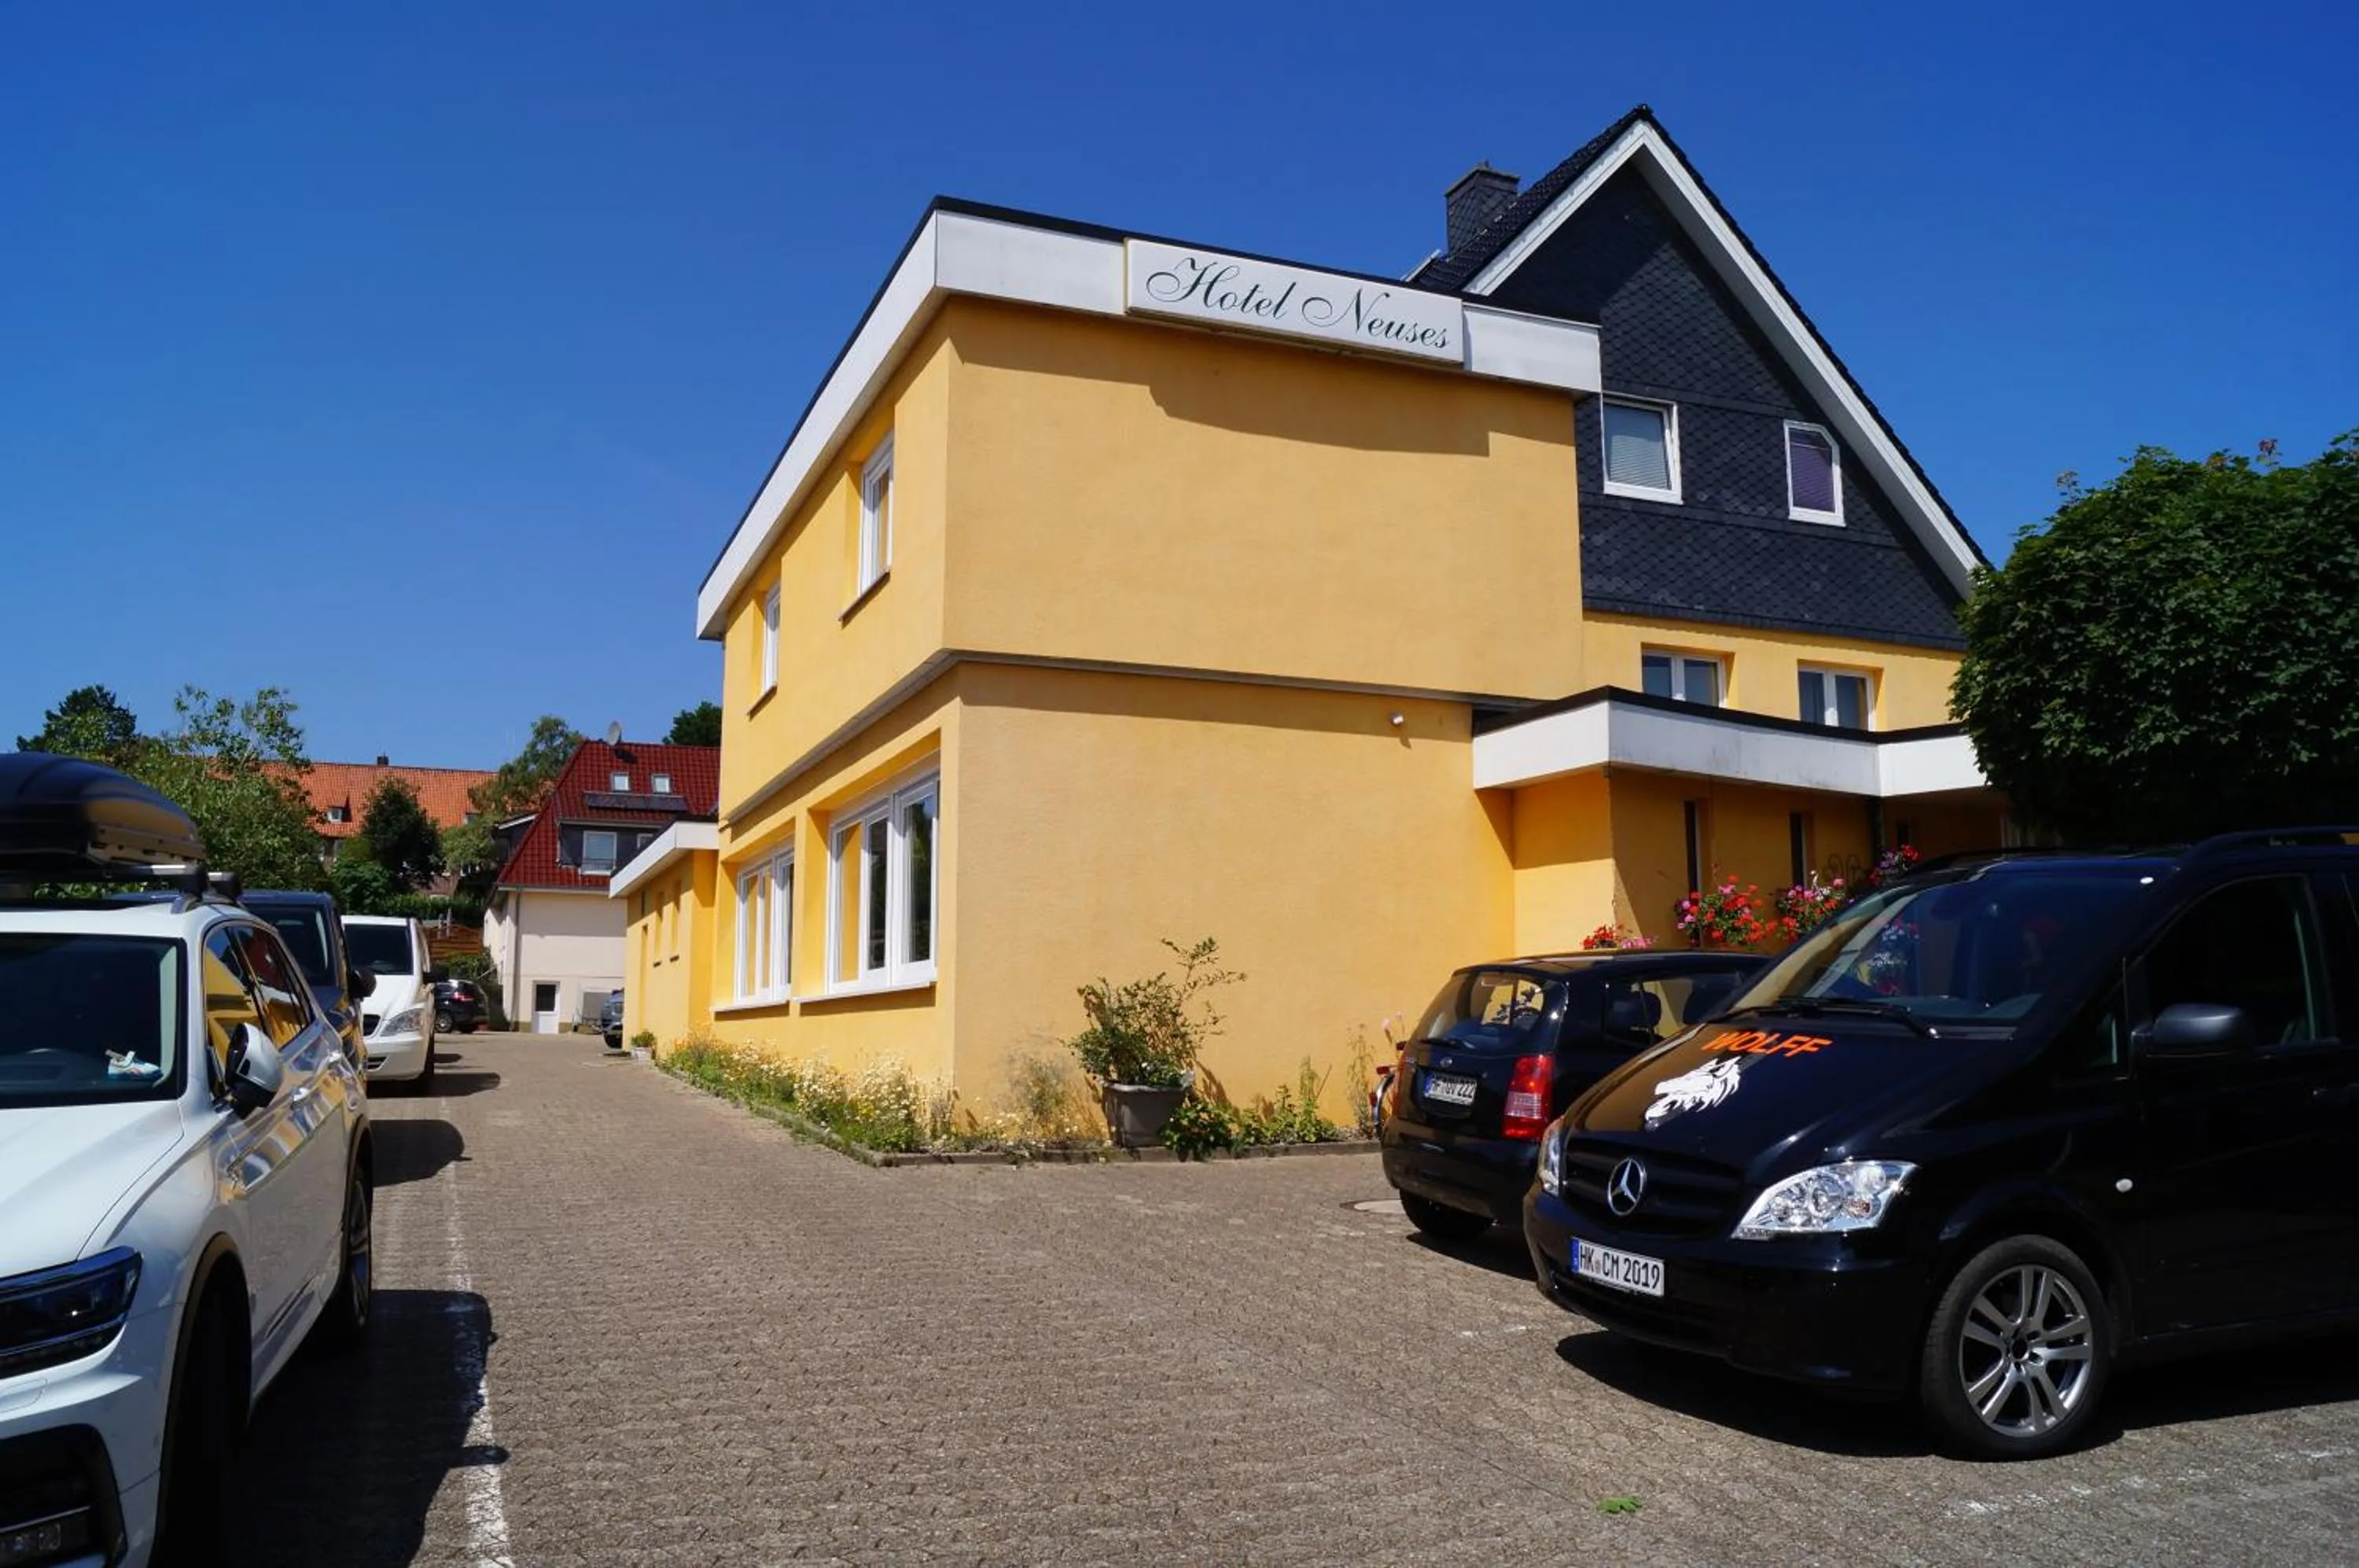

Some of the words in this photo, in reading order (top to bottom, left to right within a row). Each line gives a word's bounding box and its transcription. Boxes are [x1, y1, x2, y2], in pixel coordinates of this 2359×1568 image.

[1146, 257, 1296, 318] Hotel
[1301, 288, 1450, 348] Neuses
[1700, 1032, 1833, 1058] WOLFF
[1580, 1245, 1594, 1272] HK
[1603, 1252, 1620, 1280] CM
[1623, 1257, 1660, 1289] 2019
